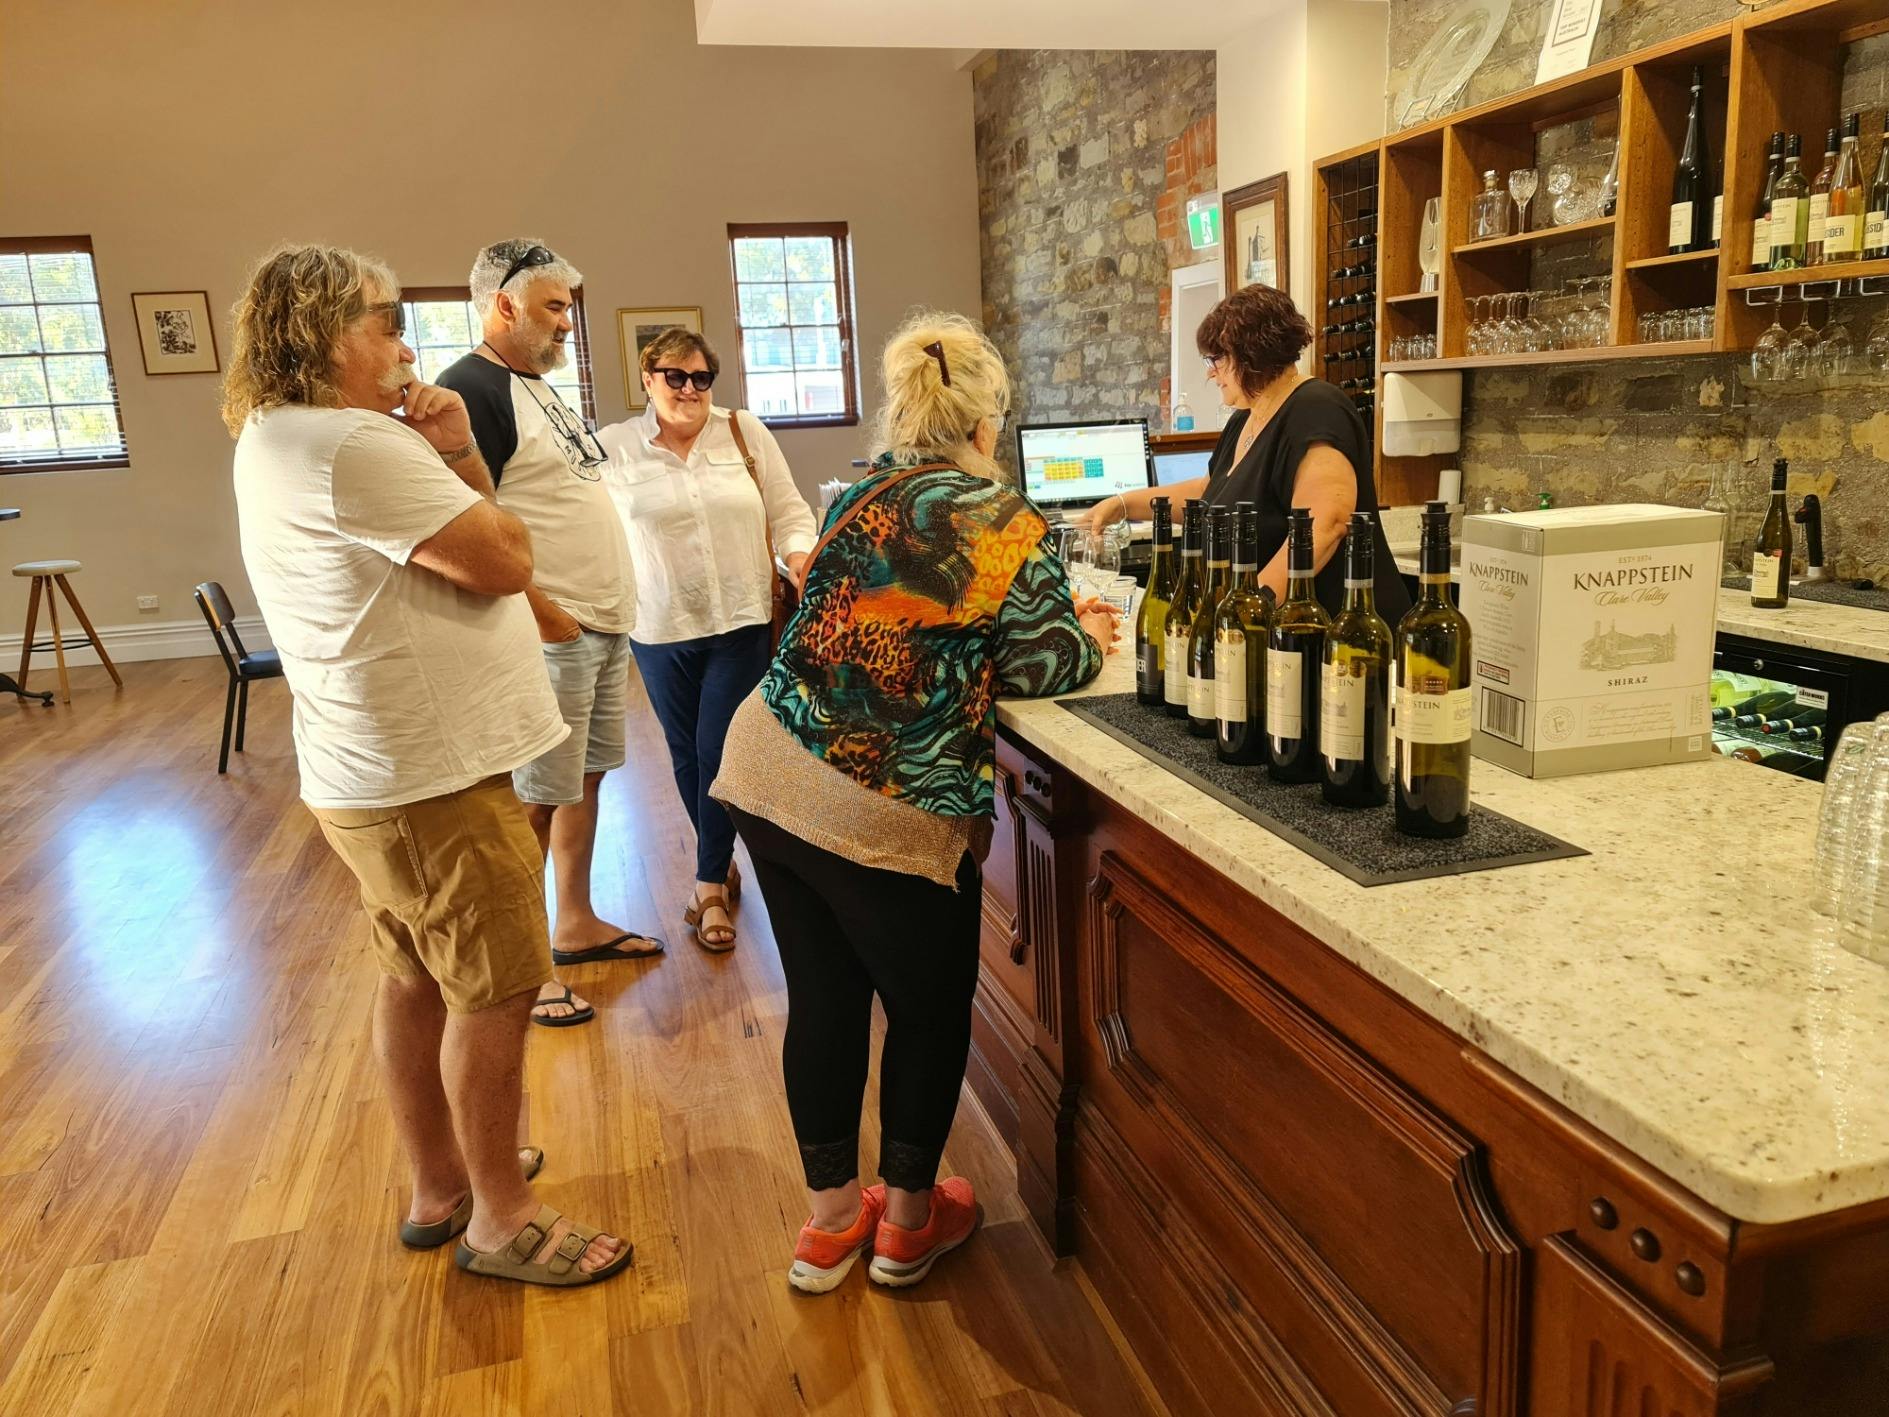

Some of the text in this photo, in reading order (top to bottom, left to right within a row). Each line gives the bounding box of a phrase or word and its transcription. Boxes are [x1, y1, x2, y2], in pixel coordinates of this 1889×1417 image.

[1469, 561, 1528, 586] KNAPPSTEIN
[1573, 563, 1694, 591] KNAPPSTEIN
[1594, 586, 1671, 606] Clare Valley
[1607, 676, 1648, 687] SHIRAZ
